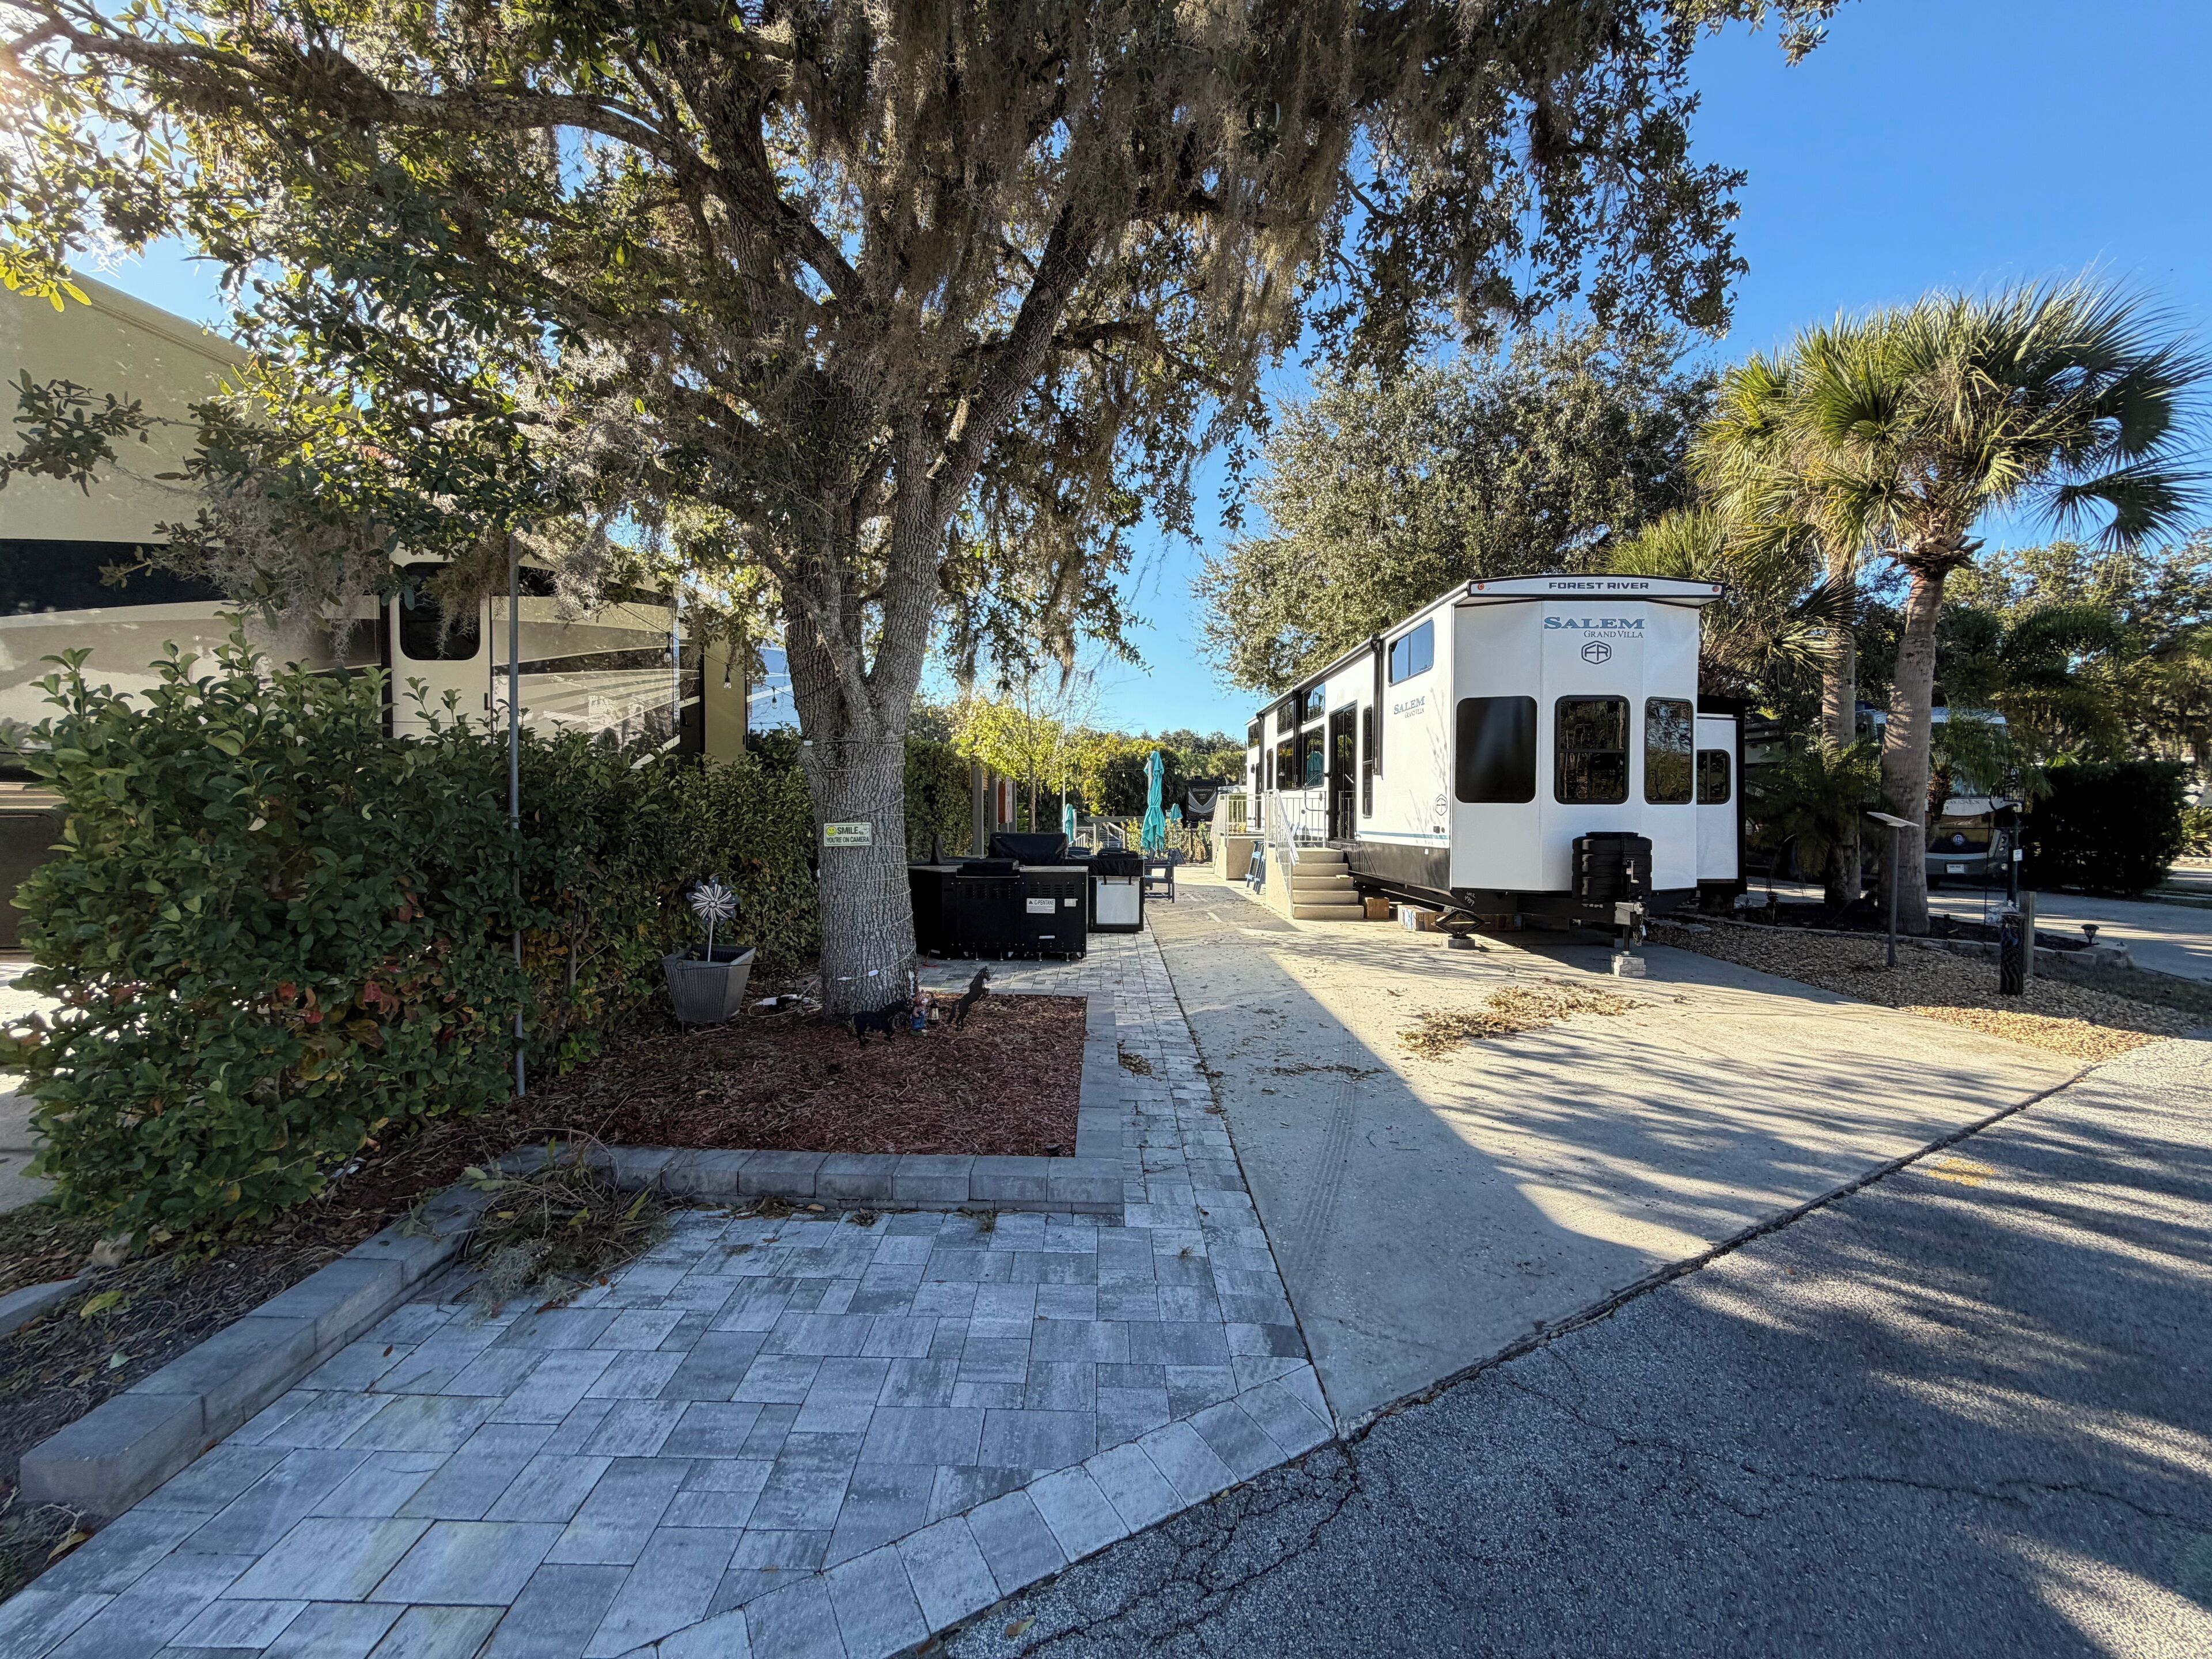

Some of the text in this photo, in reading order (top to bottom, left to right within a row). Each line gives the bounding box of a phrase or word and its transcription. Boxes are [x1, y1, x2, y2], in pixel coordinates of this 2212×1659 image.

[1544, 616, 1645, 629] SALEM
[1393, 695, 1425, 715] SALEM
[837, 826, 858, 835] SMILE
